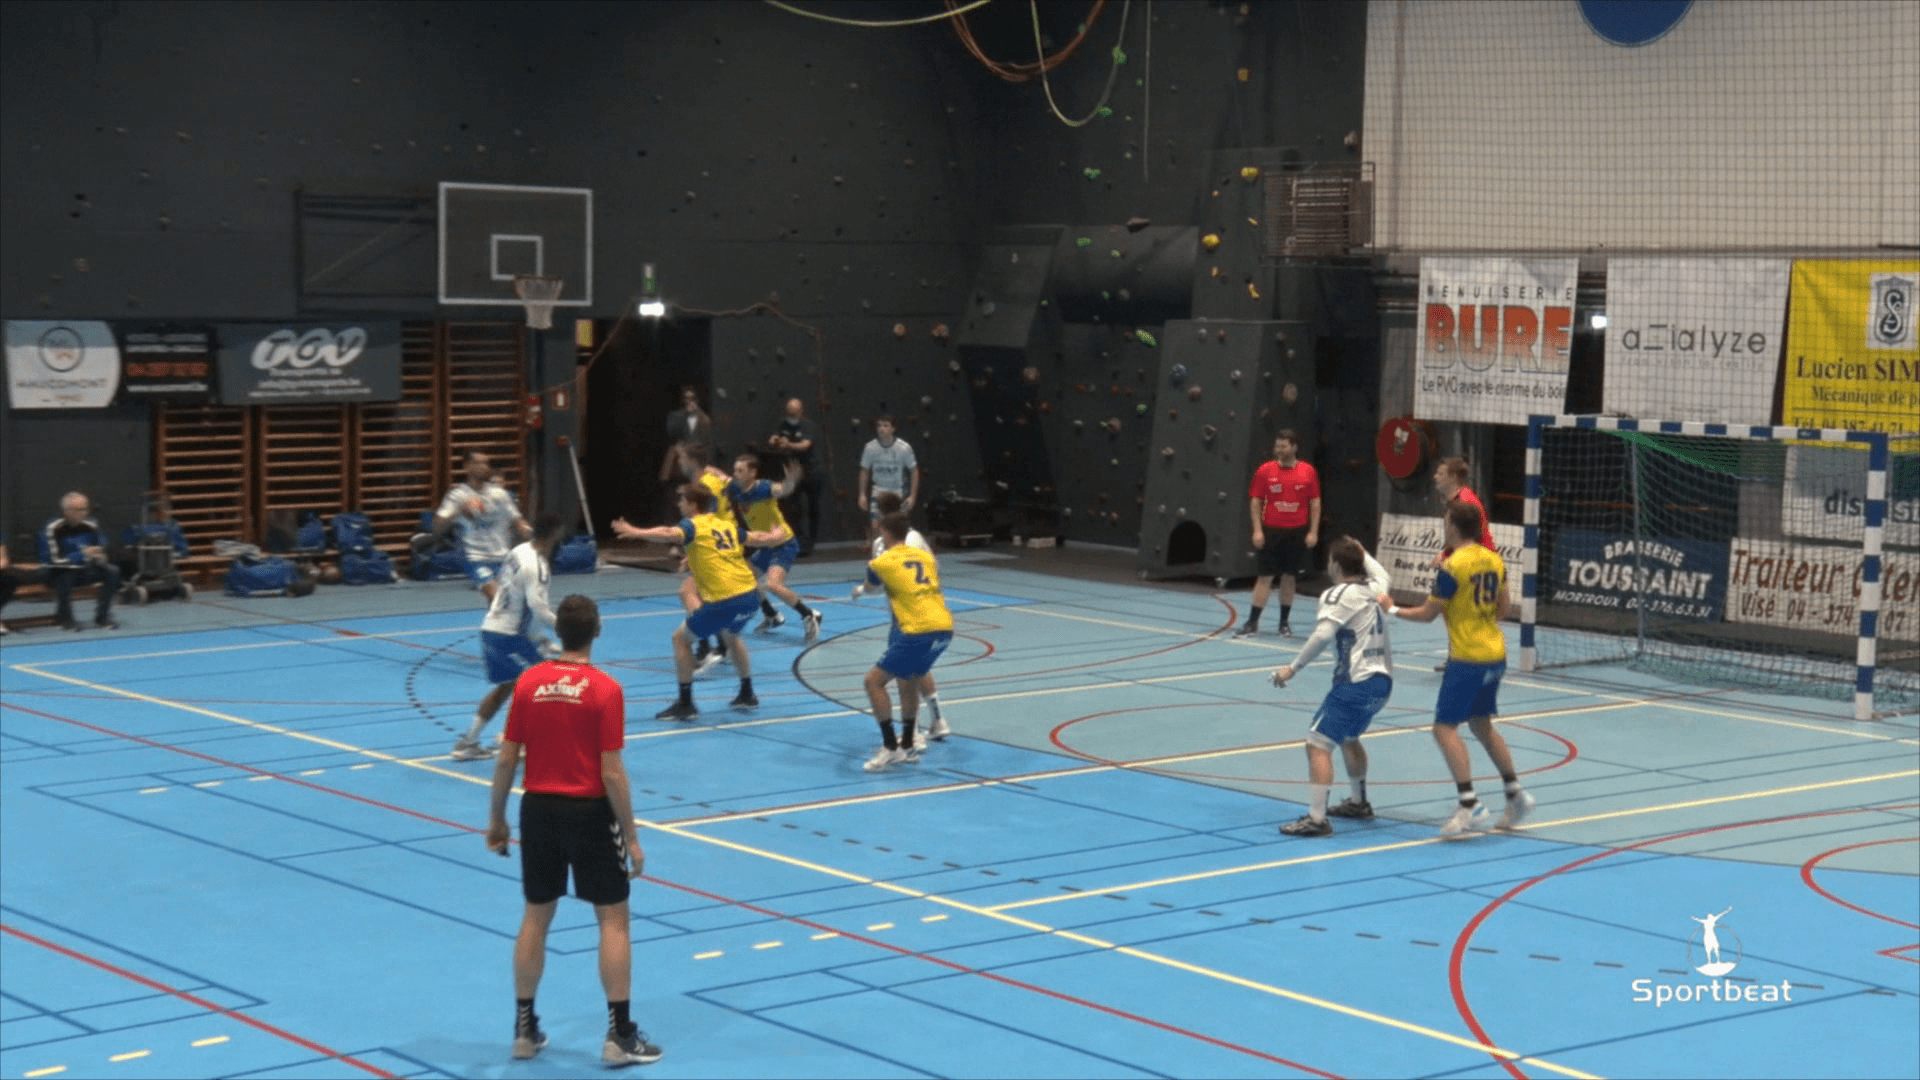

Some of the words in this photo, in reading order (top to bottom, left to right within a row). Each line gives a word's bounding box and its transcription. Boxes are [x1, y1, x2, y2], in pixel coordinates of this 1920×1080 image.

[1424, 303, 1572, 374] BURE
[1797, 356, 1868, 380] Lucien
[1422, 375, 1434, 391] Le
[1437, 376, 1457, 394] PVC
[1460, 380, 1482, 395] avec
[1533, 381, 1545, 399] du
[711, 528, 735, 550] 21
[903, 560, 930, 585] 2
[1394, 558, 1415, 571] Rue
[1417, 560, 1431, 573] du
[1733, 548, 1845, 594] Traiteur
[1553, 590, 1621, 607] MORTROUX
[1741, 591, 1776, 618] Visé
